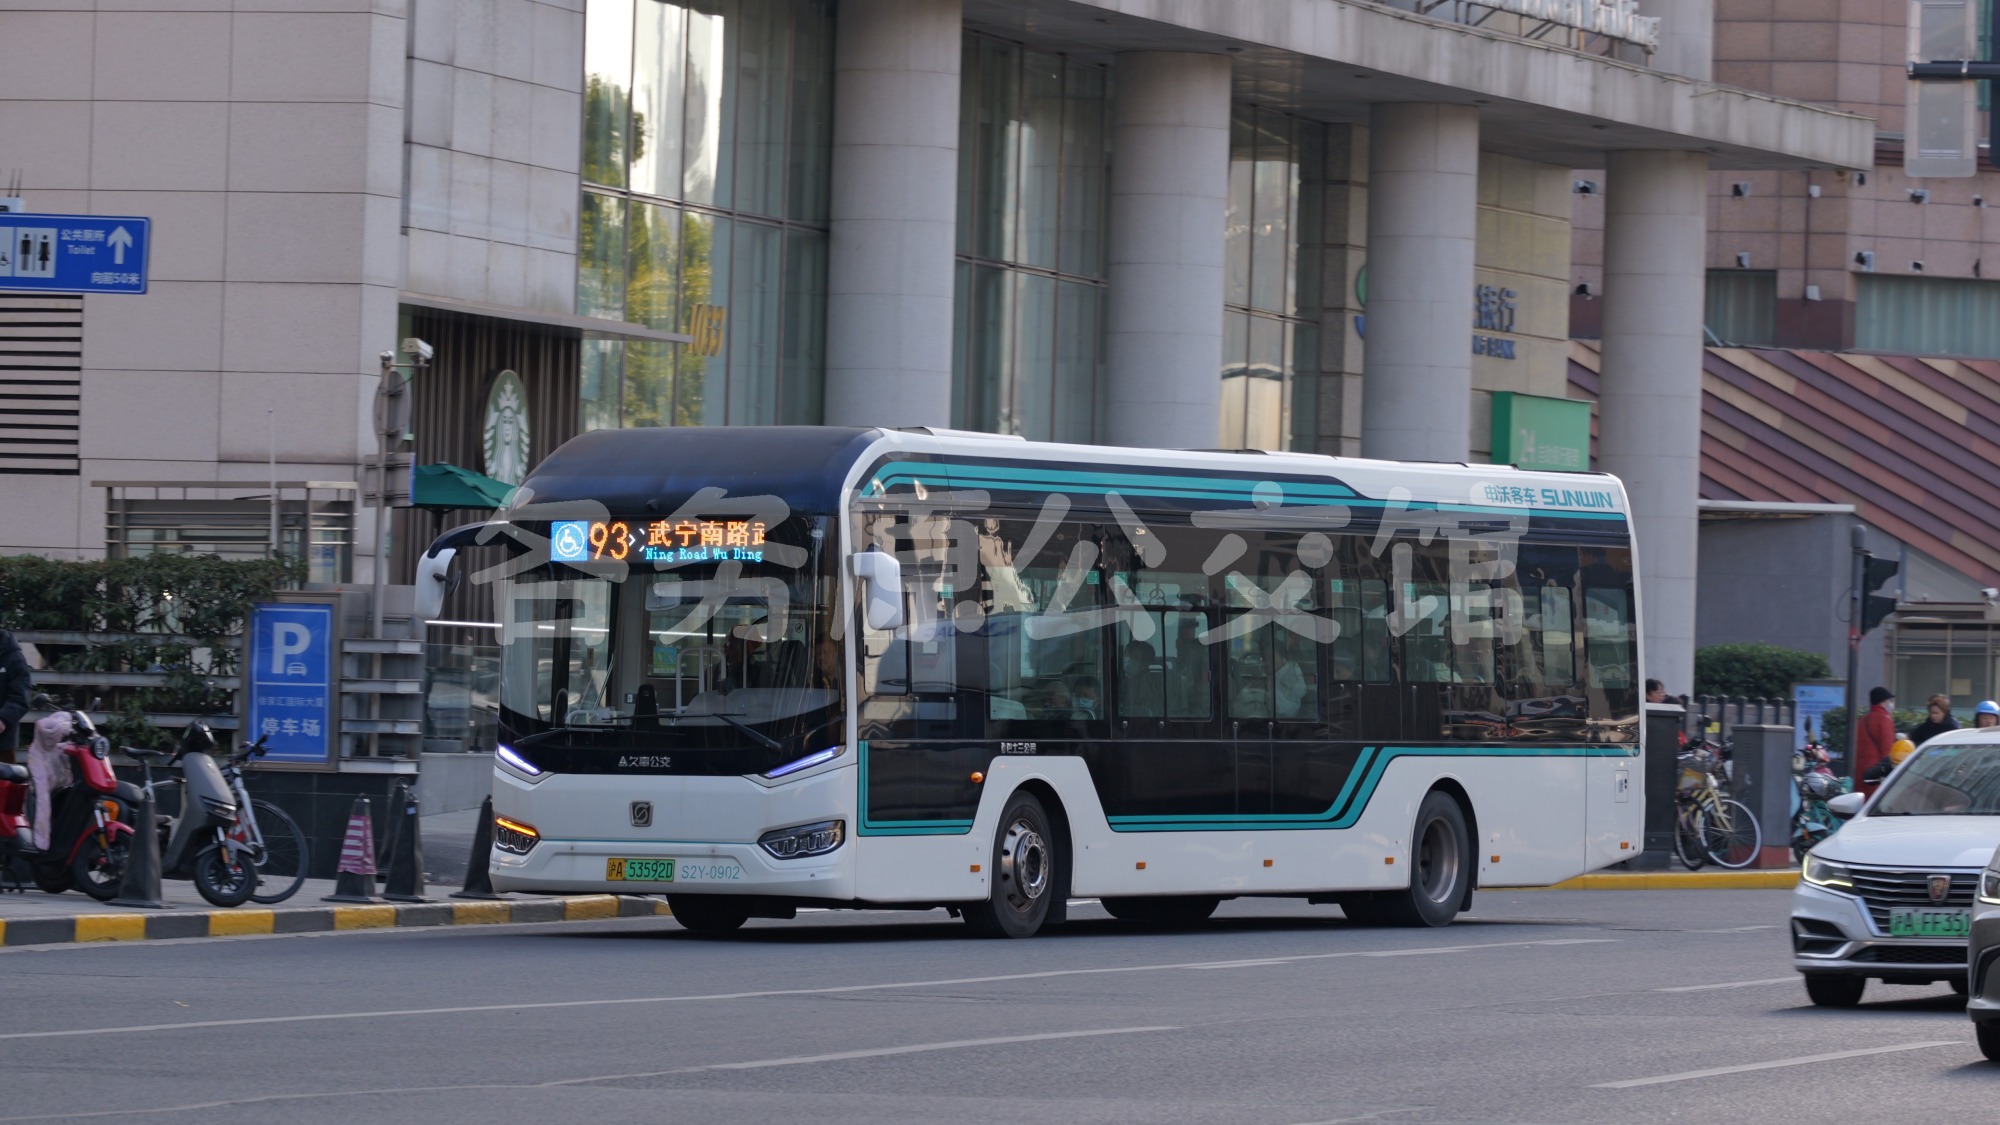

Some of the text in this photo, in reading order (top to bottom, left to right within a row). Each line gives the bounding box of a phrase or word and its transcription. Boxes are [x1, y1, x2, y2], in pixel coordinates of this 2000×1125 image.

[67, 244, 96, 255] Toilet
[91, 271, 140, 286] 向前50米
[1520, 428, 1536, 463] 24
[1484, 485, 1614, 509] 申沃客车 SUNWIN
[589, 521, 629, 560] 93
[645, 547, 763, 562] Ning Road Wu Ding
[271, 622, 311, 675] P
[261, 717, 321, 737] 停车场
[628, 755, 671, 768] 久事公交
[681, 865, 740, 880] S2Y-0902
